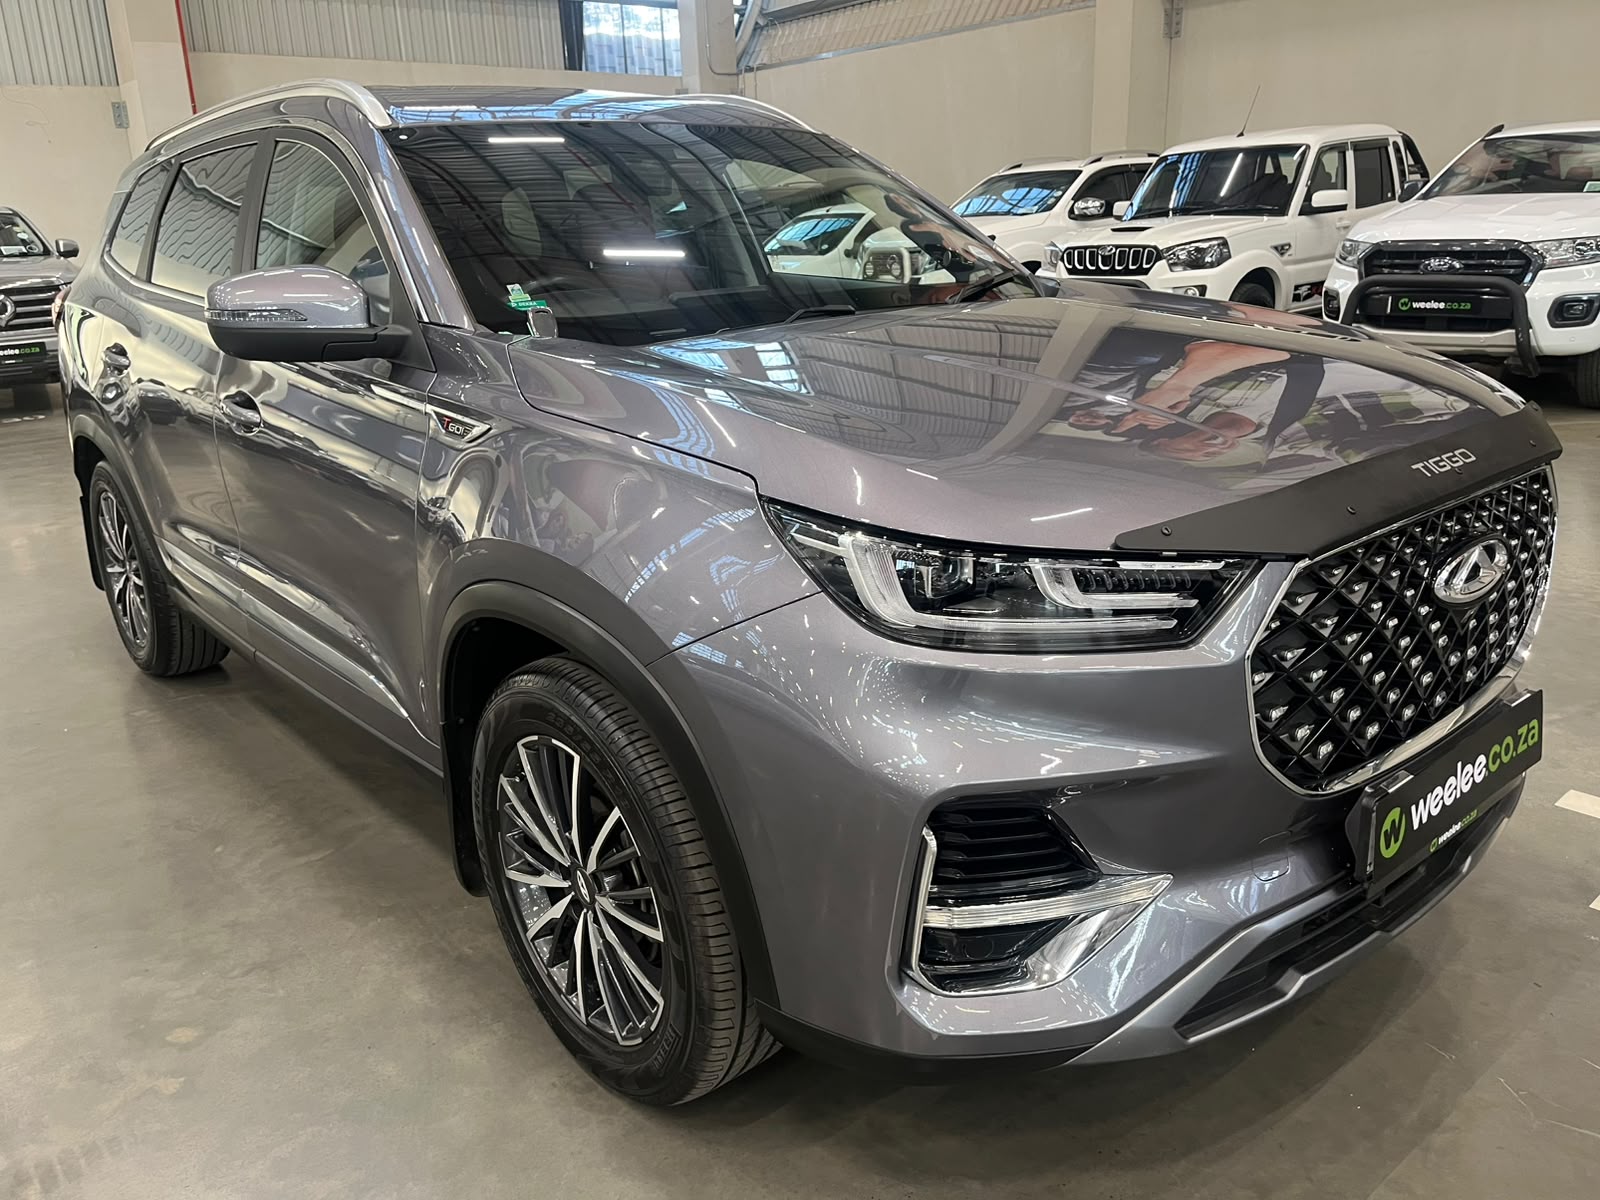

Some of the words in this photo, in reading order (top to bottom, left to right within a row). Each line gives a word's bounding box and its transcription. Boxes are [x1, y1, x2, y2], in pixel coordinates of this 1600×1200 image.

[1412, 300, 1471, 310] weelee.co.za
[1411, 448, 1477, 477] TIGGO
[1410, 718, 1539, 831] weelee.co.za
